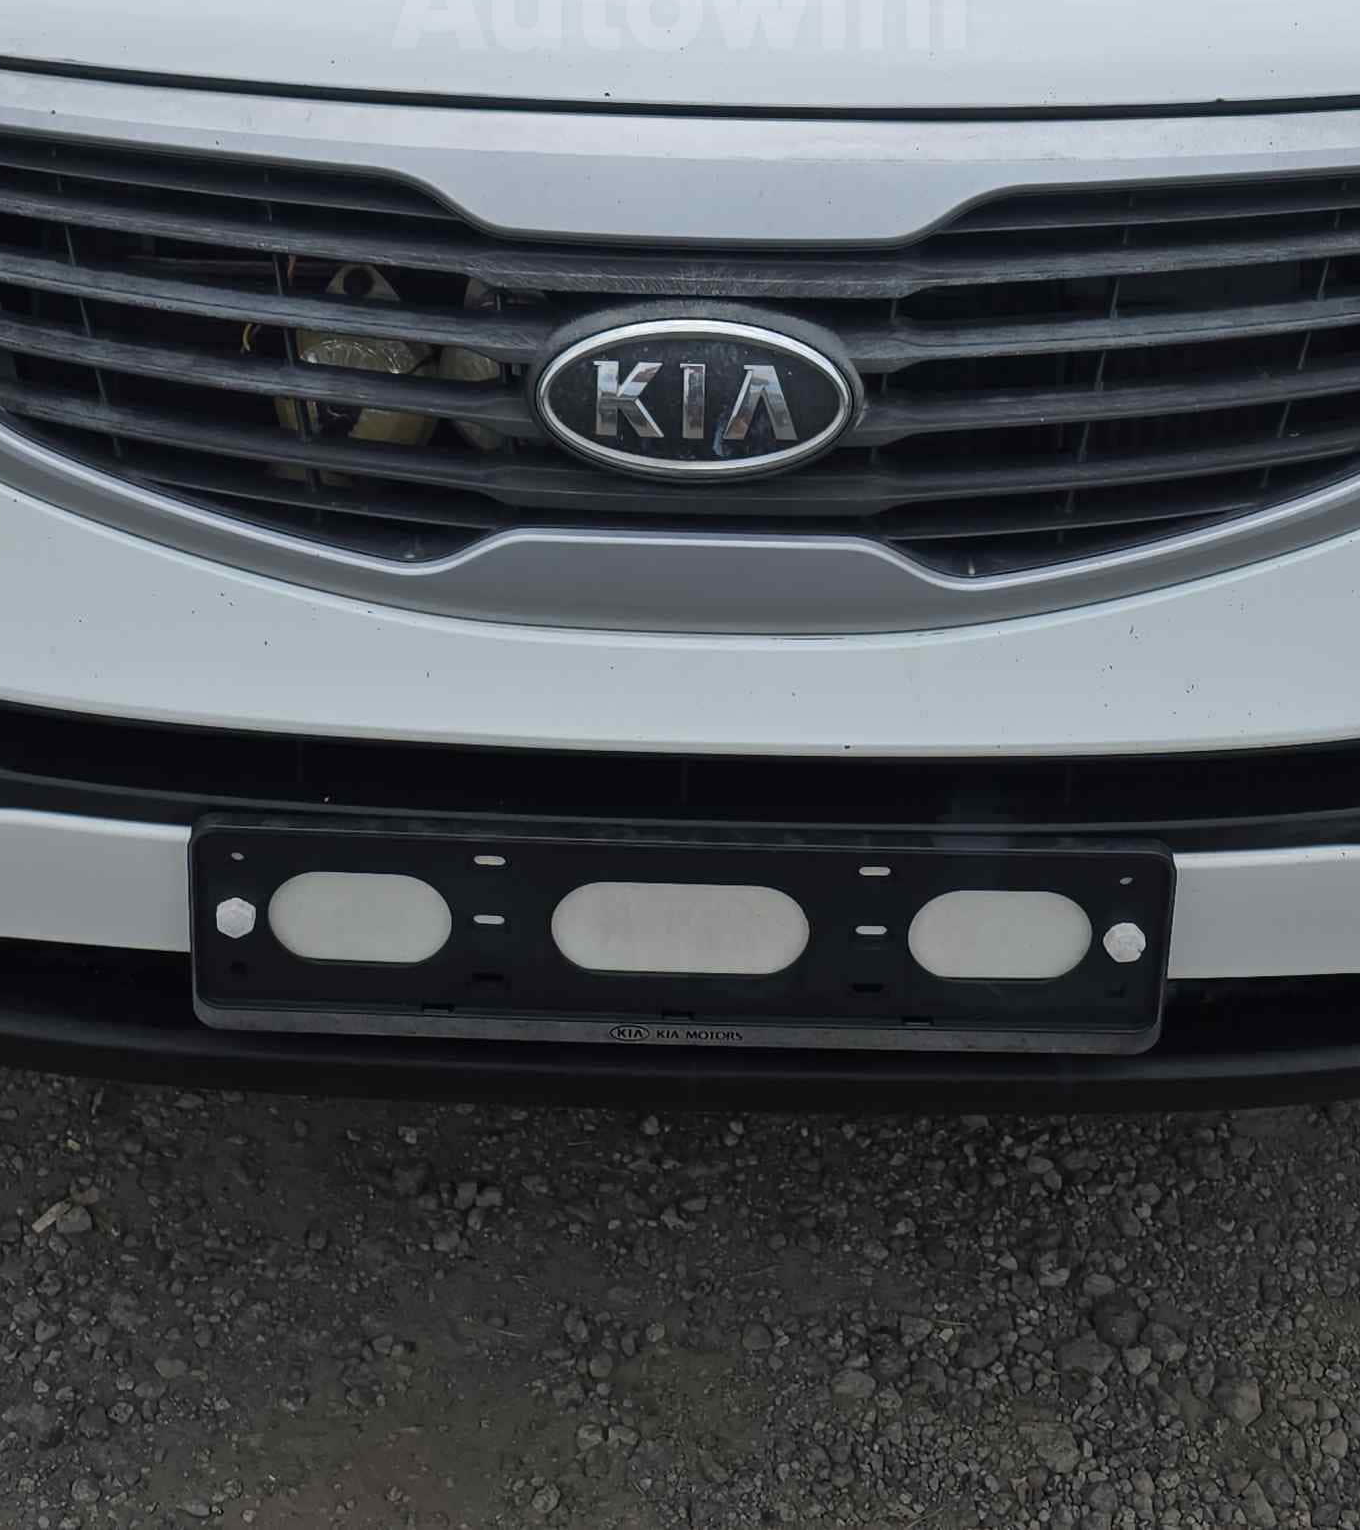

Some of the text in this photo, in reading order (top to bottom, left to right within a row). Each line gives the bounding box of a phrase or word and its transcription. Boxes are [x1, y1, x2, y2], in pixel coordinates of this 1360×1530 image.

[592, 360, 799, 441] KIA
[655, 1029, 680, 1039] KIA
[685, 1030, 744, 1041] MOTORS
